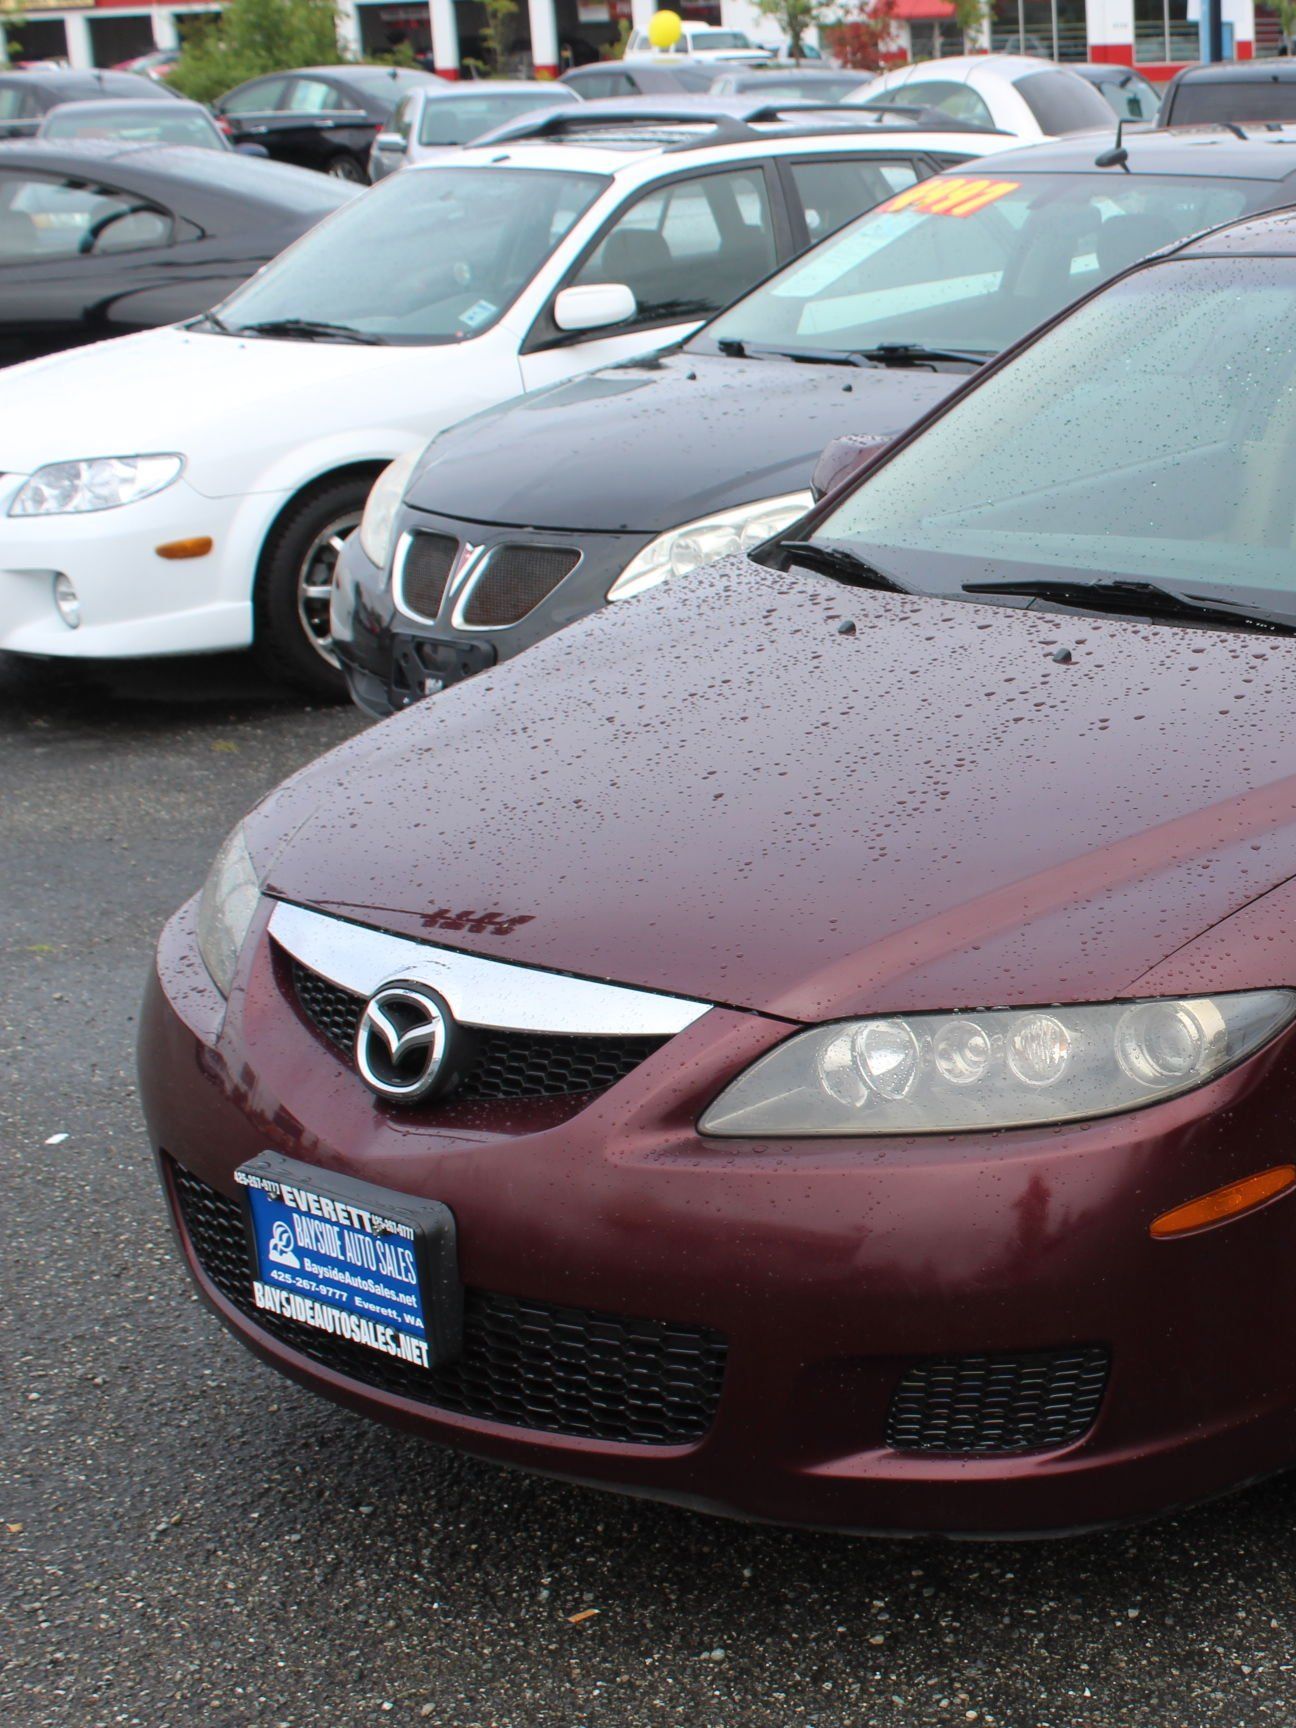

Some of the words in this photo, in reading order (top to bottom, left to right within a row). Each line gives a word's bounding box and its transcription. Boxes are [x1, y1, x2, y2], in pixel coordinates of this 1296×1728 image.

[280, 1183, 372, 1234] EVERETT
[292, 1212, 345, 1261] BAYSIDE
[343, 1229, 377, 1272] AUTO
[375, 1239, 417, 1285] SALES
[270, 1269, 348, 1302] 425-267-9777
[354, 1295, 402, 1323] Everett,
[403, 1312, 425, 1329] WA
[303, 1257, 418, 1308] BaysideAutoSales.net
[252, 1281, 430, 1369] BAYSIDEAUTOSALES.NET
